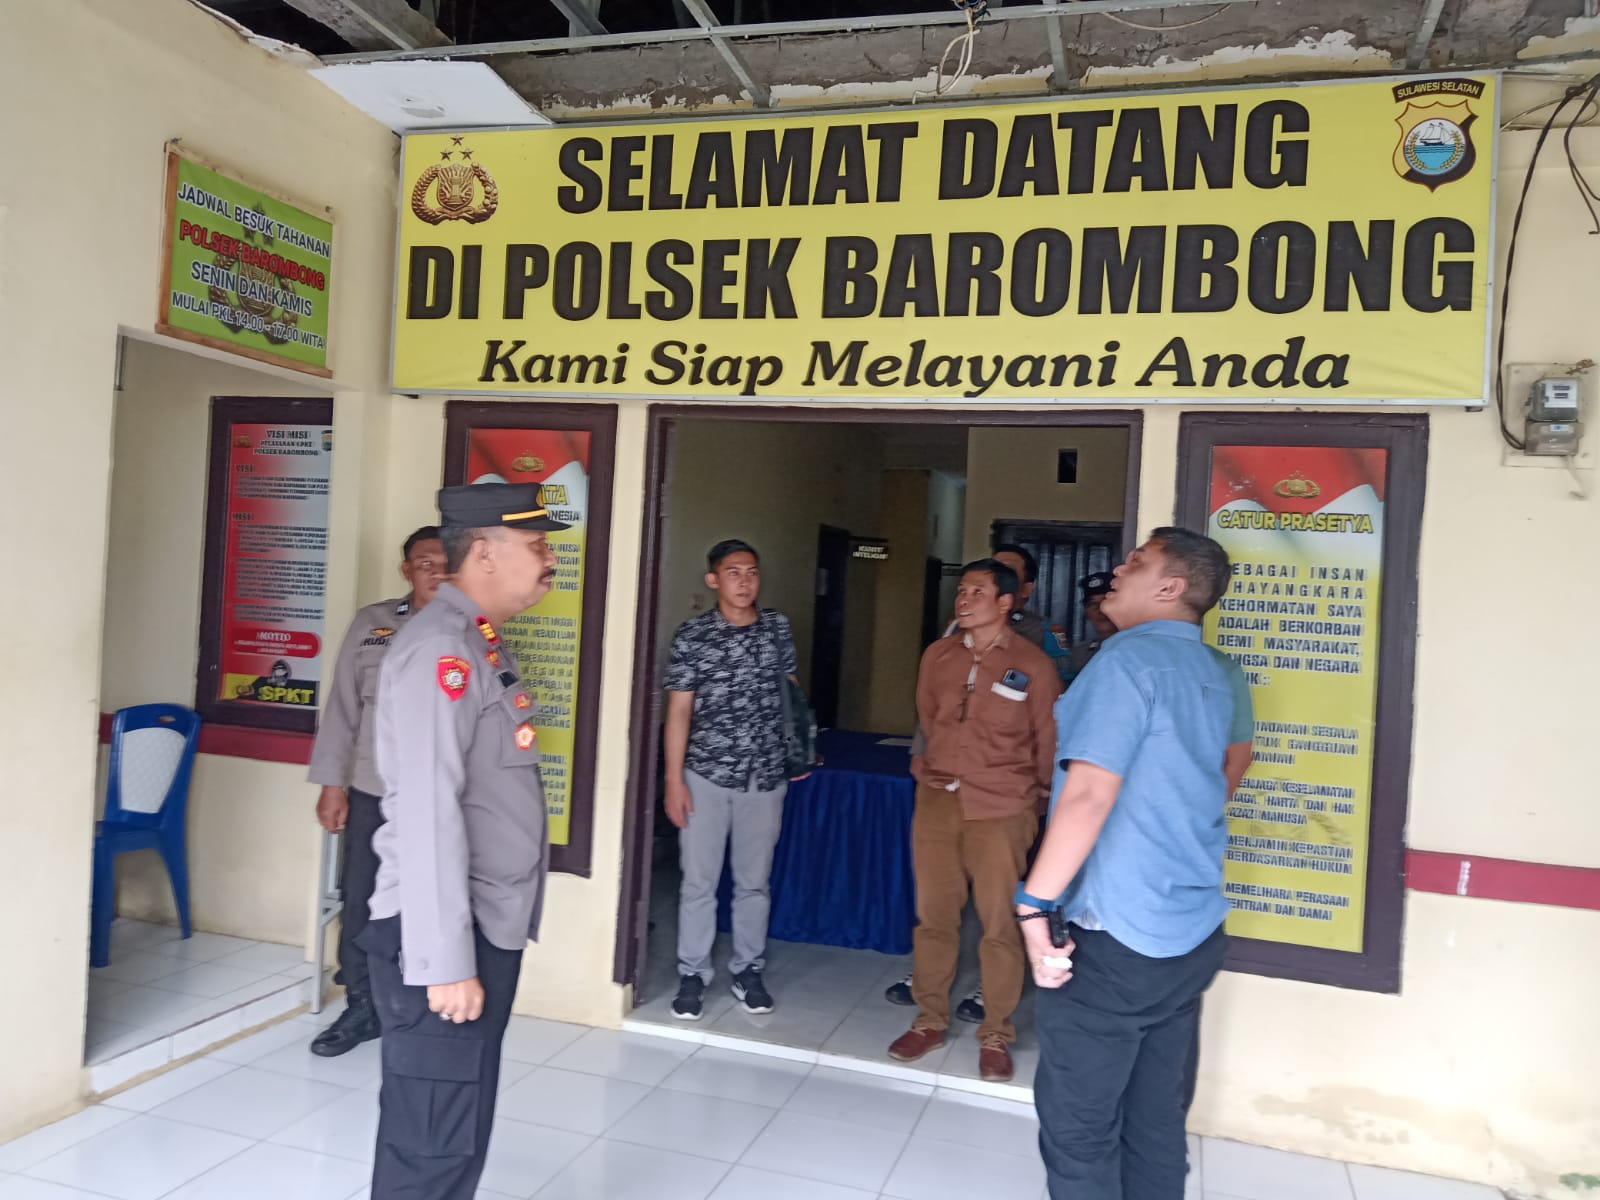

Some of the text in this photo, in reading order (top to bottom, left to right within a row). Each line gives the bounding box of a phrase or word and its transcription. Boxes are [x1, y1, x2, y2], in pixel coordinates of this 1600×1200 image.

[1397, 81, 1479, 98] SULAWESI SELATAN
[557, 100, 1310, 214] SELAMAT DATANG
[178, 184, 330, 258] JADWAL BESUK TAHANAN
[179, 219, 325, 291] POLSEK BAROMBONG
[406, 216, 1475, 321] DI POLSEK BAROMBONG
[191, 260, 313, 317] SENIN DAN KAMIS
[172, 291, 209, 316] MULAI
[211, 303, 234, 323] PKL
[235, 311, 264, 332] 14.00
[271, 322, 299, 342] 17.00
[301, 331, 324, 349] WITA
[478, 336, 1350, 397] Kami Siap Melayani Anda
[266, 430, 308, 439] VISI MISI
[1217, 509, 1374, 533] CATUR PRASETYA
[1231, 562, 1365, 582] EBAGAI INSAN
[1233, 580, 1365, 600] HAYANGKARA
[1219, 598, 1363, 619] KEHORMATAN SAYA
[1217, 616, 1361, 637] ADALAH BERKORBAN
[1217, 634, 1361, 657] DEMI MASYARAKAT,
[1273, 656, 1300, 670] DAN
[1305, 657, 1360, 674] NEGARA
[258, 685, 315, 704] SPKT
[1226, 849, 1353, 875] BERDASARKAN HUKUM
[1225, 882, 1350, 907] MEMELIHARA PERASAAN
[1275, 903, 1296, 917] DAN
[1299, 907, 1333, 921] DAMAI
